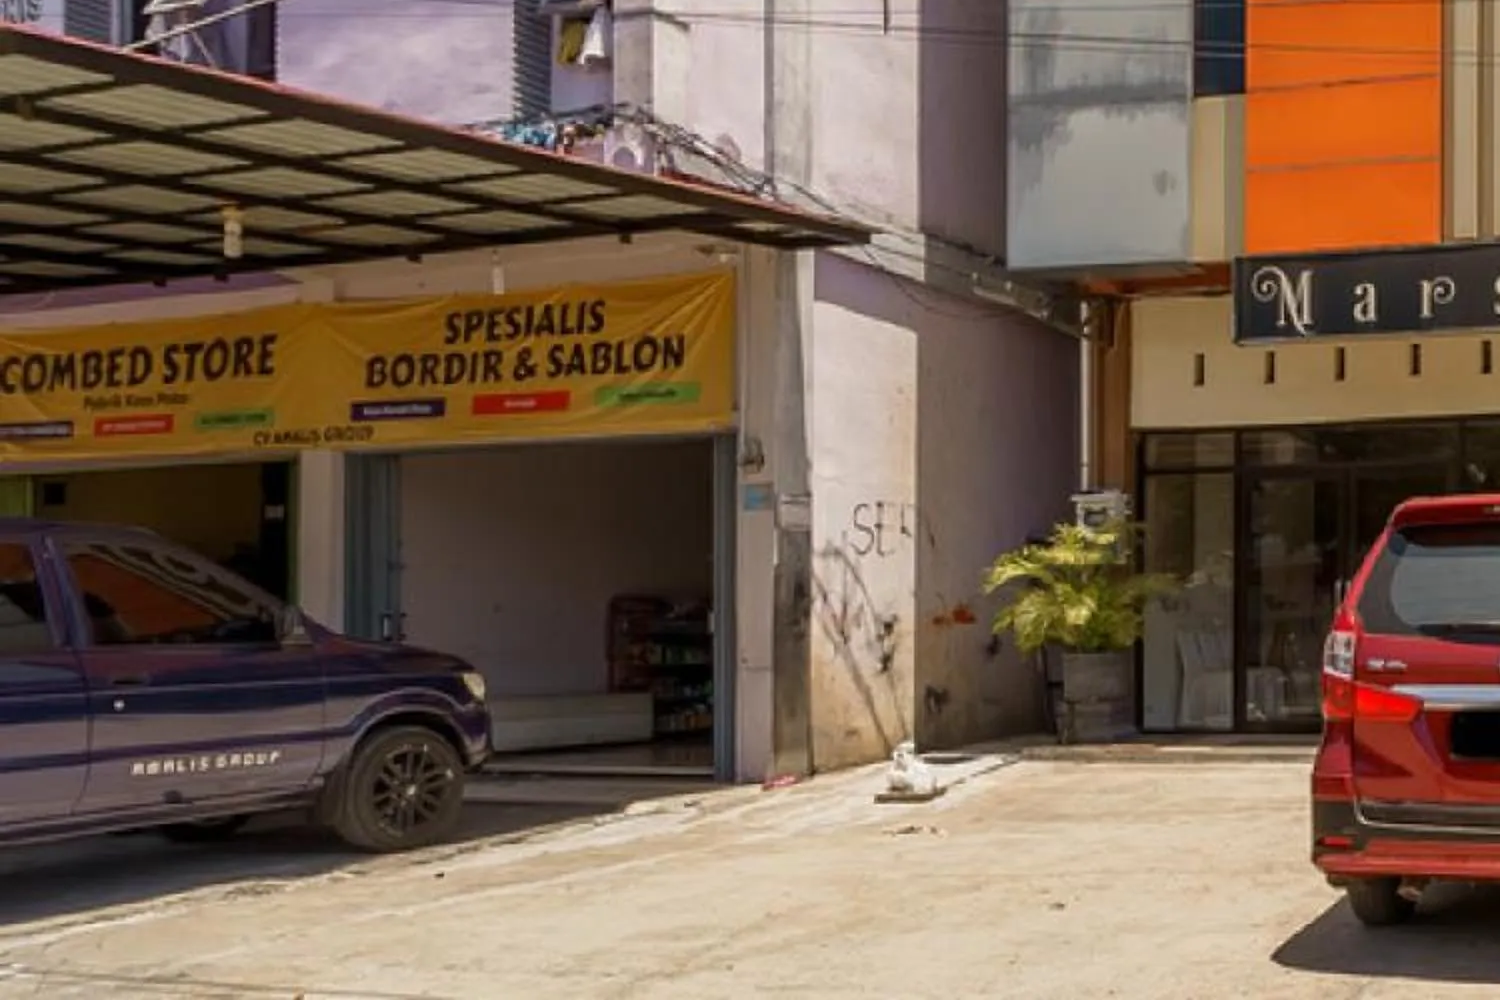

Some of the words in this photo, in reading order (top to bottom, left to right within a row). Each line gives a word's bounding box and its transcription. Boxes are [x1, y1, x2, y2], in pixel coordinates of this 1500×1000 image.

[445, 300, 606, 345] SPESIALIS
[0, 346, 152, 394] COMBED
[163, 334, 278, 384] STORE
[365, 348, 503, 388] BORDIR
[512, 350, 538, 382] &
[546, 334, 686, 378] SABLON
